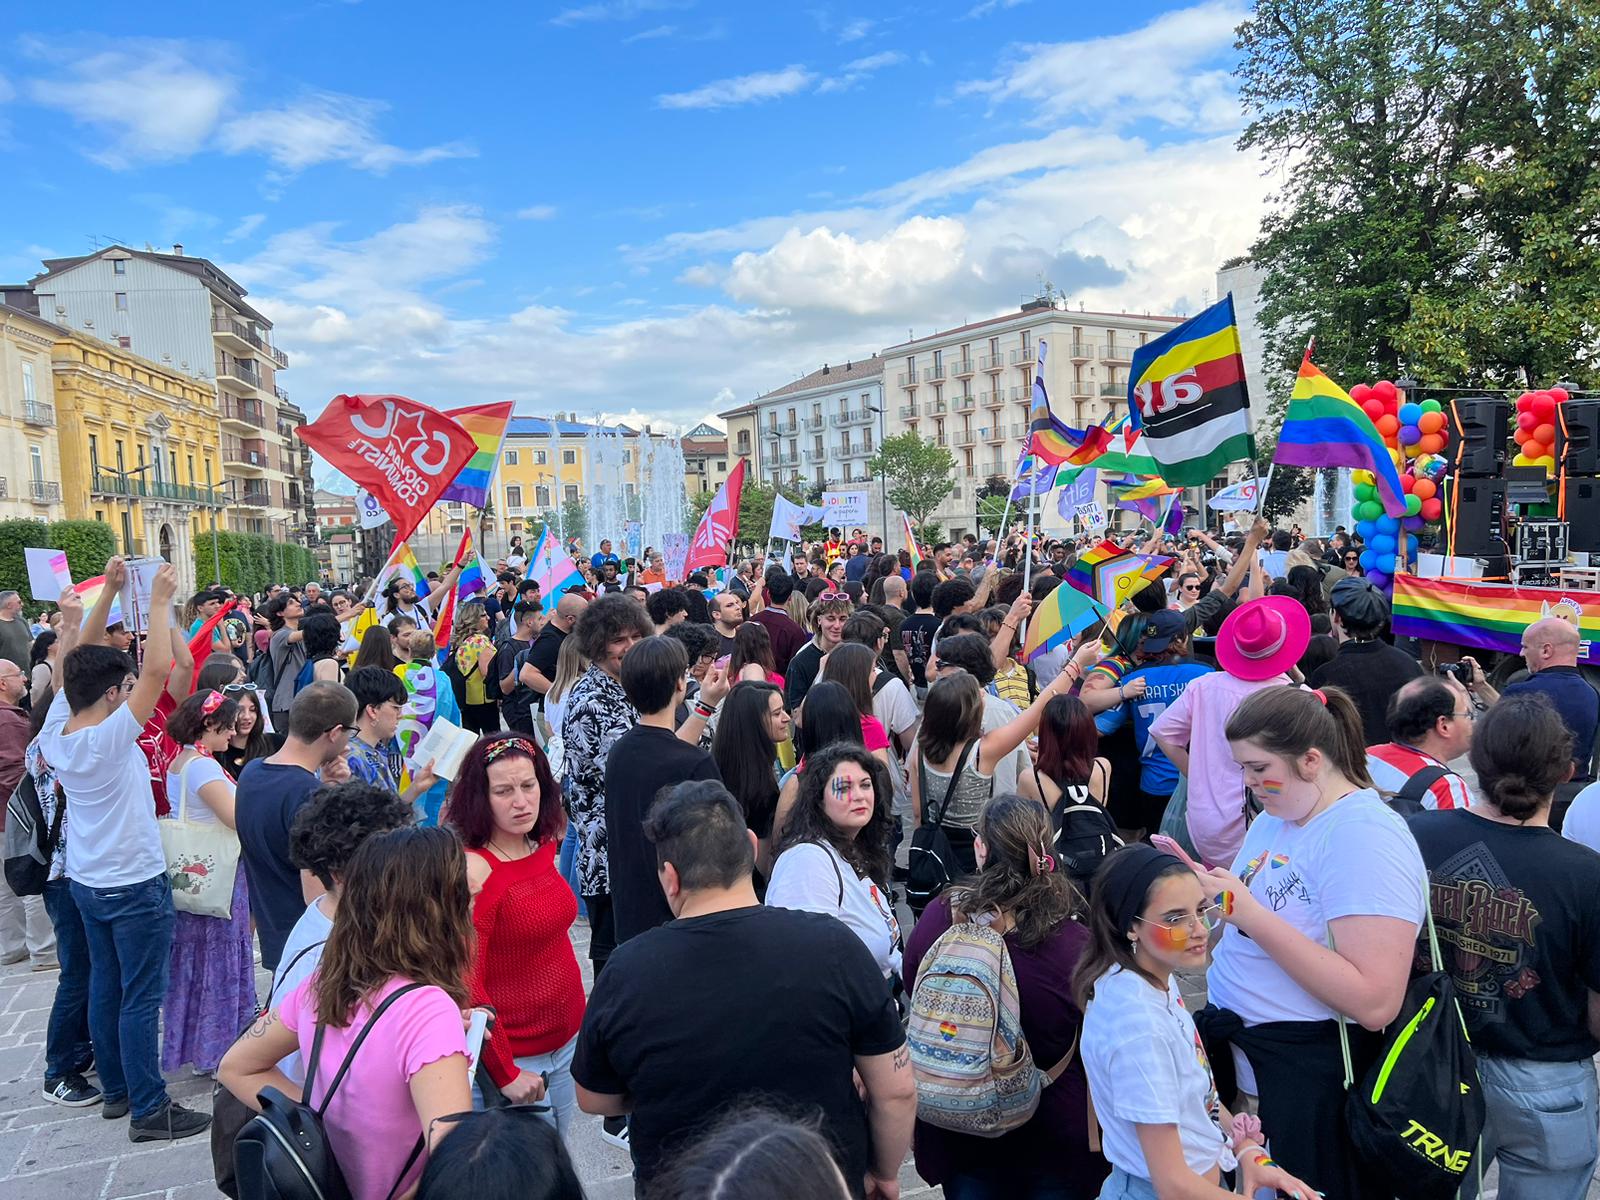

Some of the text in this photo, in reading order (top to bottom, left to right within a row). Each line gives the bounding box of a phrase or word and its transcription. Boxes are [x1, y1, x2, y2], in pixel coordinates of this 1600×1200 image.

[1137, 702, 1167, 758] 7
[1464, 879, 1539, 947] Rock
[1489, 948, 1511, 962] 1971
[1400, 1119, 1472, 1172] TRNG
